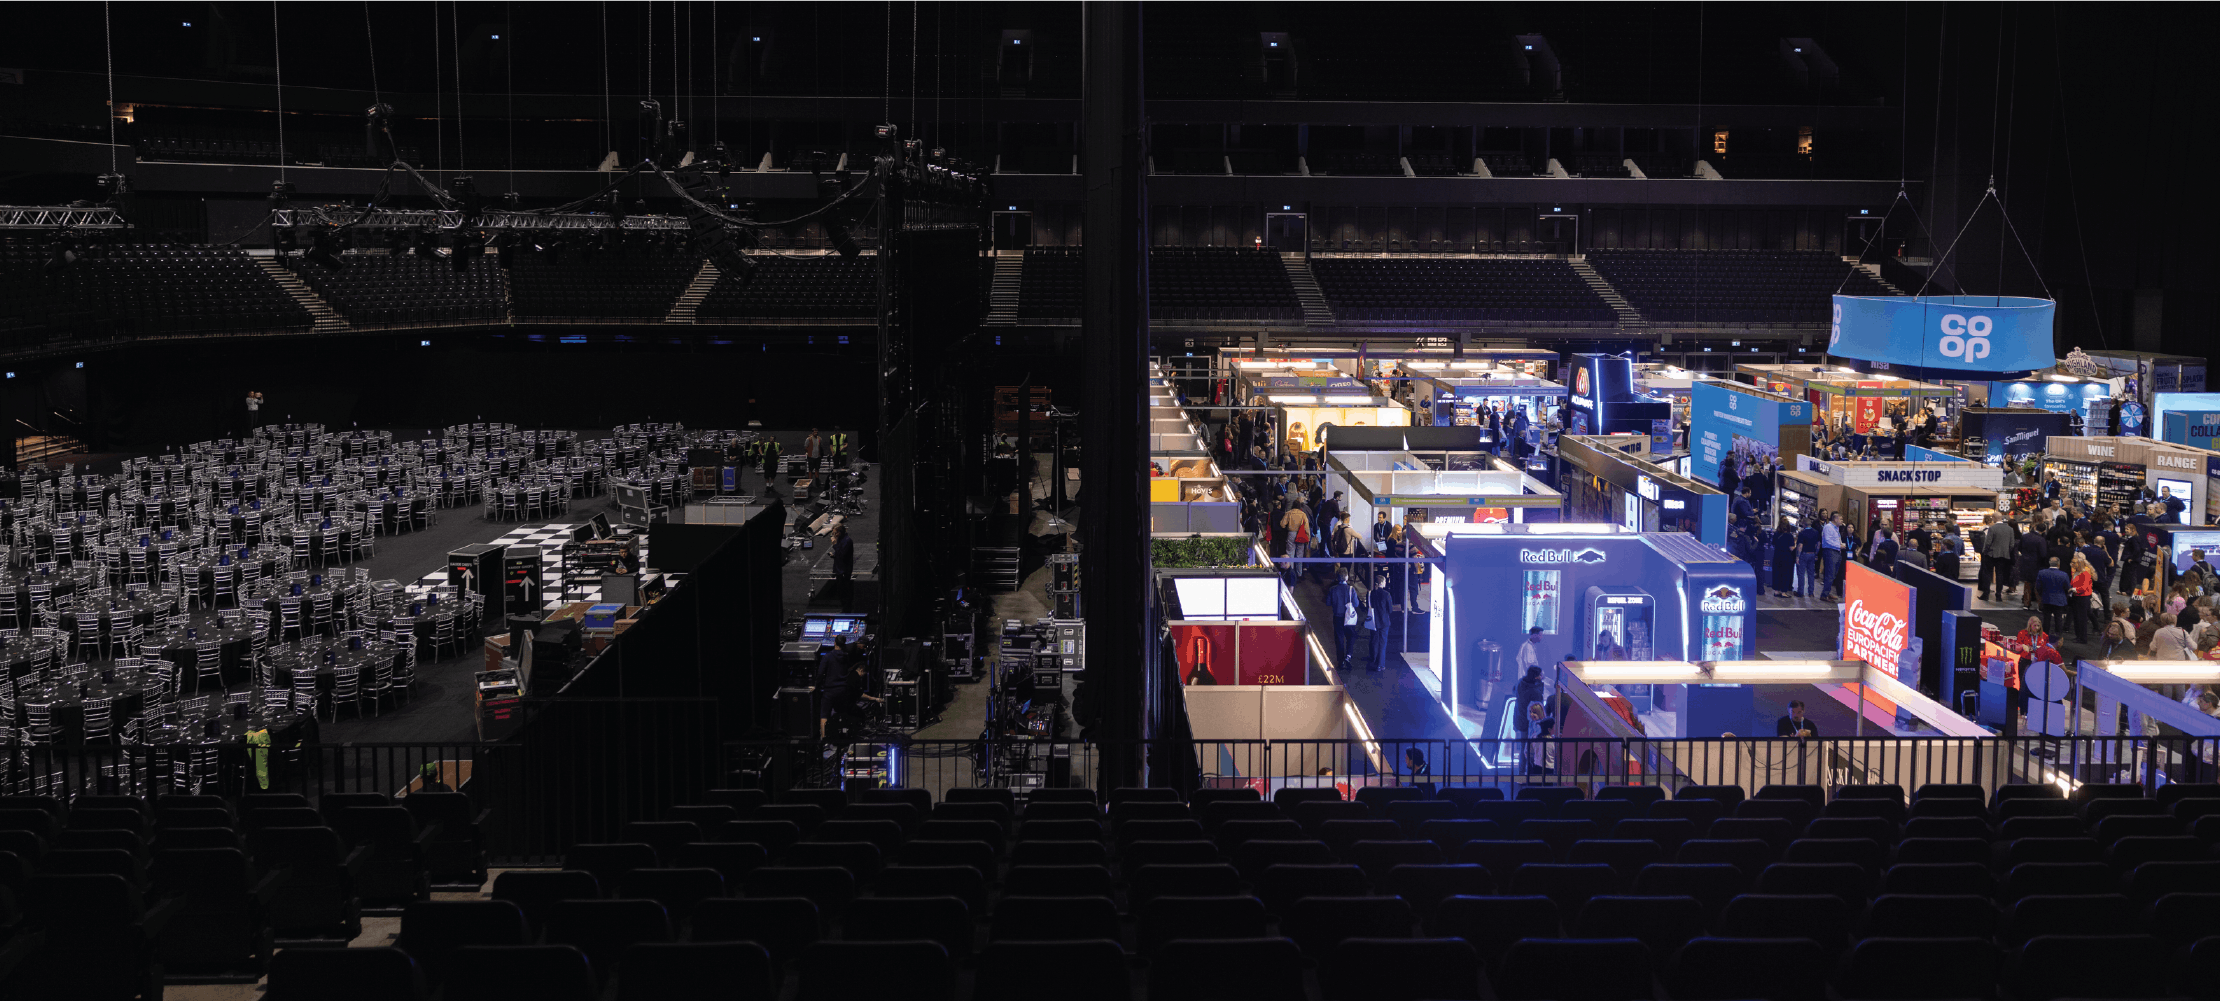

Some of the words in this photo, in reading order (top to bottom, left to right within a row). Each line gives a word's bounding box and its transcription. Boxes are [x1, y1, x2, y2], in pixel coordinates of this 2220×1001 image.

[2087, 444, 2115, 457] WINE
[2157, 455, 2197, 470] RANGE
[1878, 470, 1914, 482] SNACK
[1914, 470, 1942, 482] STOP
[1522, 550, 1546, 562] Red
[1547, 550, 1571, 562] Bull
[1703, 601, 1723, 611] Red
[1724, 601, 1744, 611] Bull
[1257, 674, 1285, 684] £22M
